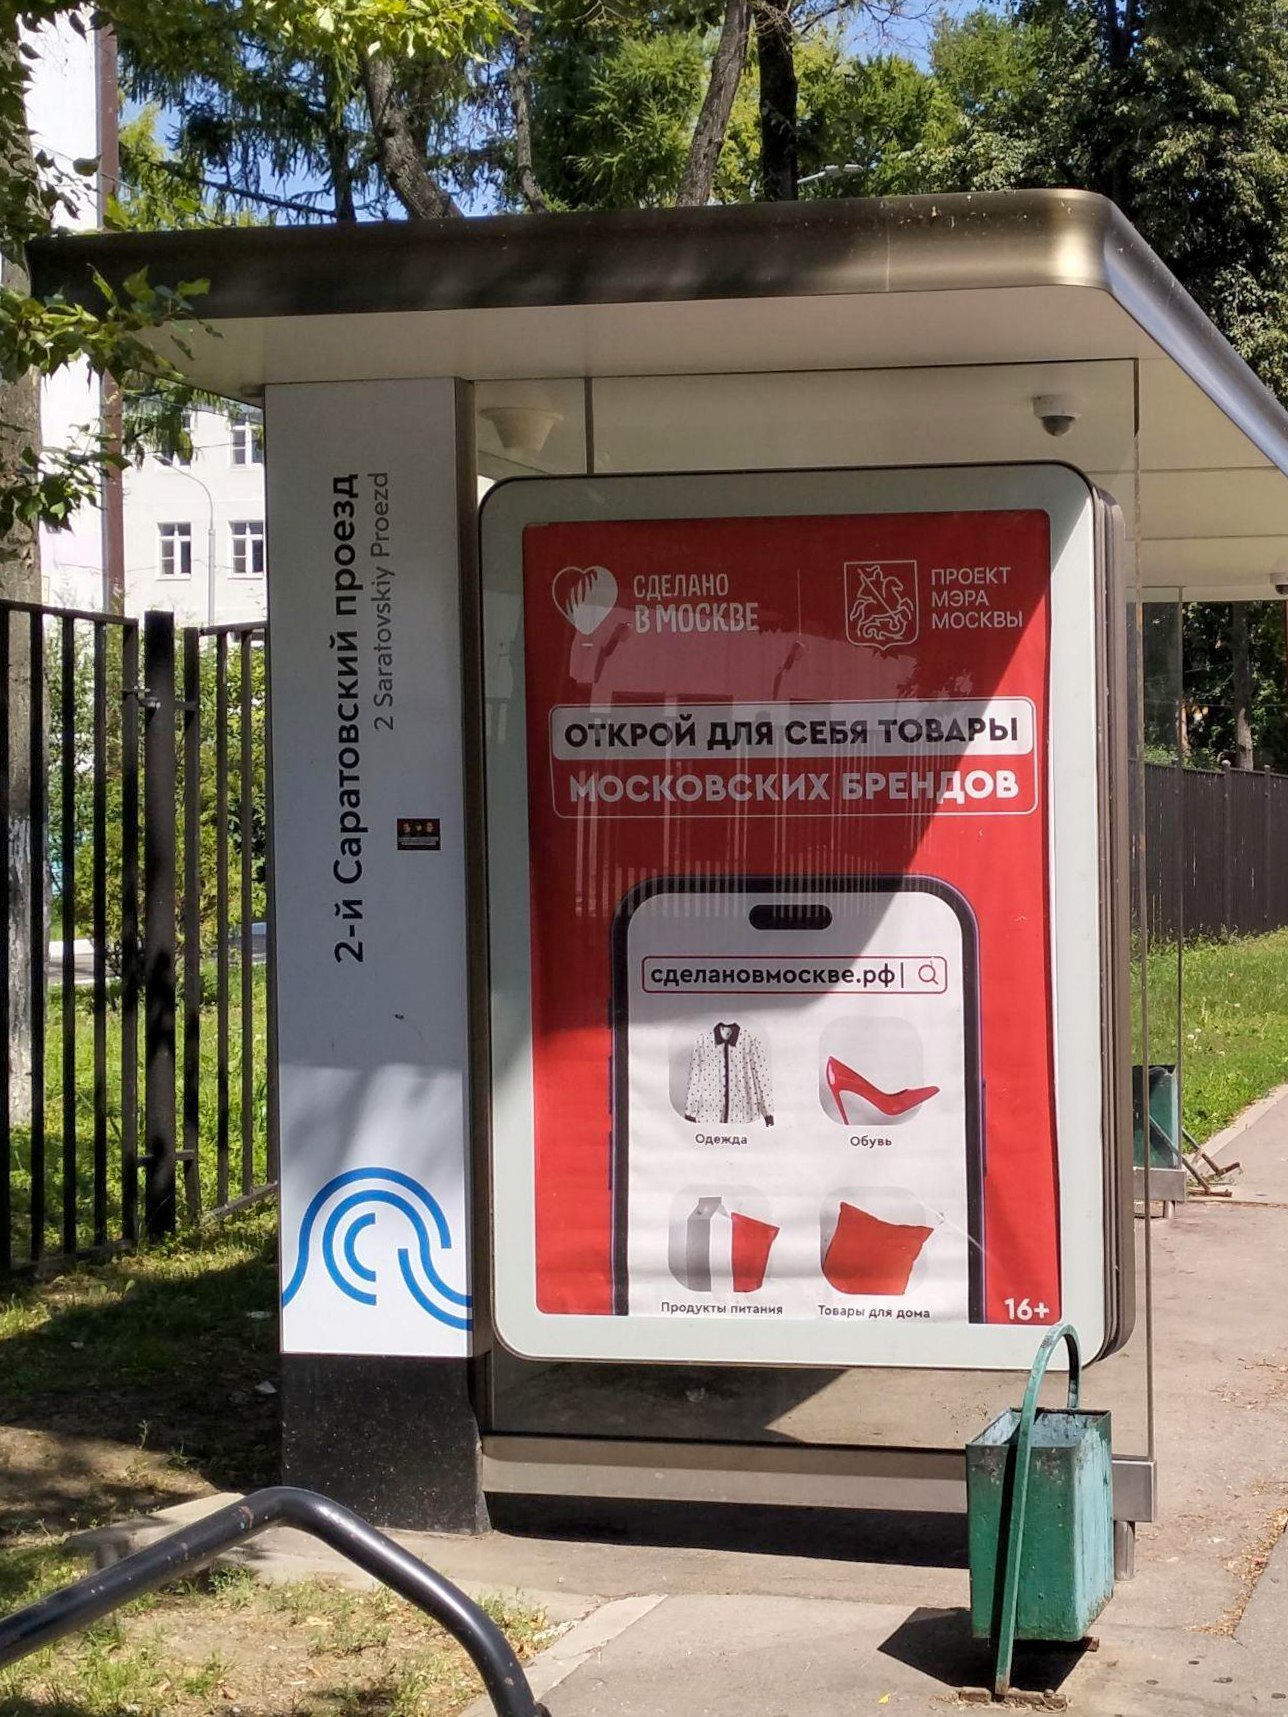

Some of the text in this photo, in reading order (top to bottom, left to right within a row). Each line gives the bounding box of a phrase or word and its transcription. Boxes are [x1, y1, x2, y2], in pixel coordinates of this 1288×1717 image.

[633, 573, 729, 601] СДЕЛАНО
[930, 566, 1011, 586] ПРОЕКТ
[368, 471, 396, 730] 2 Saratovskiy Proezd
[930, 589, 988, 608] МЭРА
[635, 602, 759, 634] В МОСКВЕ
[930, 611, 1023, 629] МОСКВЫ
[329, 473, 368, 963] 2-й Саратовский проезд
[563, 714, 1018, 750] ОТКРОЙ ДЛЯ СЕБЯ ТОВАРЫ
[569, 770, 1019, 804] МОСКОВСКИХ БРЕНДОВ
[650, 962, 896, 989] сделановмоскве.рф
[694, 1132, 748, 1148] Одежда
[849, 1134, 892, 1149] Обувь
[661, 1301, 783, 1316] Продукты питания
[817, 1304, 930, 1319] Товары для дома
[1004, 1297, 1050, 1320] 16+
